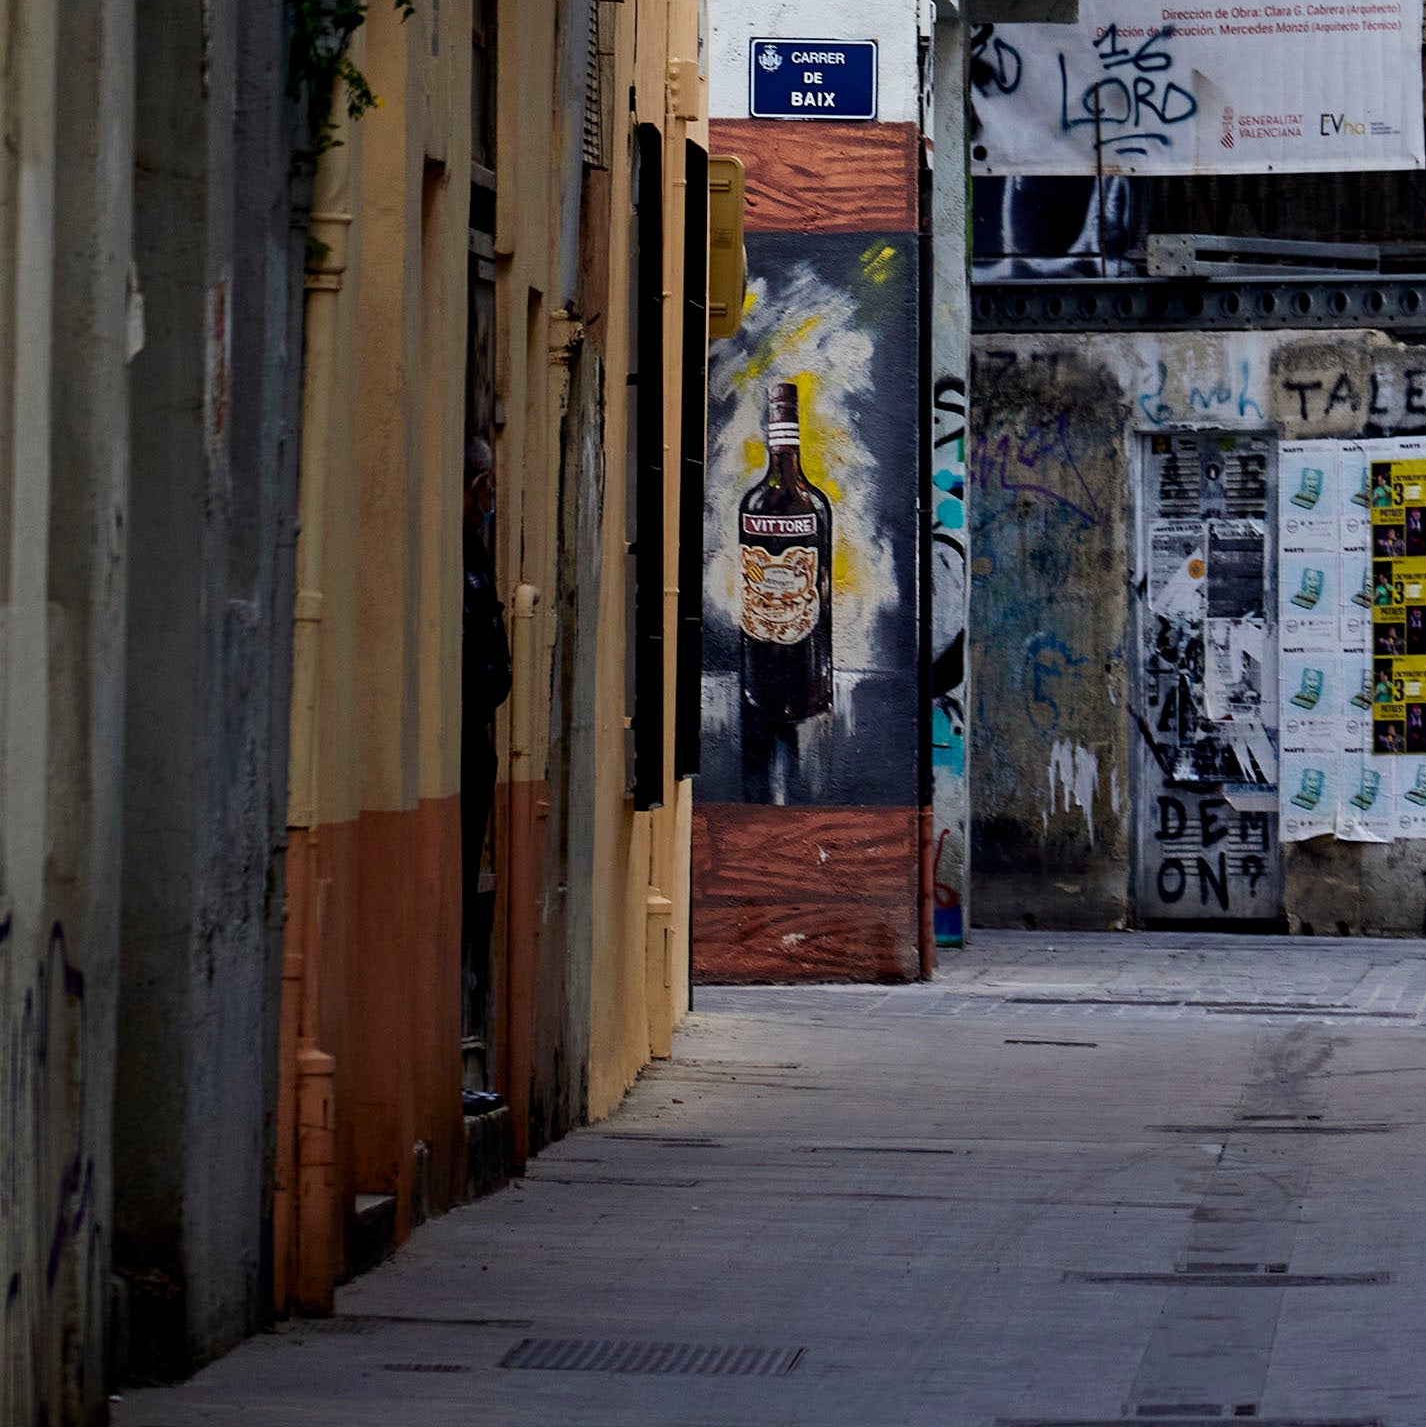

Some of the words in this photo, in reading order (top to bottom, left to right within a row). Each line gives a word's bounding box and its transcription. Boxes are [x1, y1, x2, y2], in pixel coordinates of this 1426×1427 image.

[1162, 8, 1212, 21] Dirección
[1215, 7, 1228, 19] de
[1231, 6, 1262, 19] Obra:
[1264, 4, 1292, 17] Clara
[1307, 3, 1345, 16] Cabrera
[1219, 23, 1273, 36] Mercedes
[791, 51, 846, 65] CARRER
[803, 72, 824, 84] DE
[791, 91, 836, 107] BAIX
[1057, 51, 1198, 132] LORD
[1238, 114, 1304, 127] GENERALITAT
[1320, 113, 1367, 136] EVha
[1239, 126, 1302, 139] VALENCIANA
[1393, 482, 1405, 506] 3
[751, 518, 811, 534] VITTORE
[1393, 581, 1405, 605] 3
[1393, 677, 1405, 702] 3
